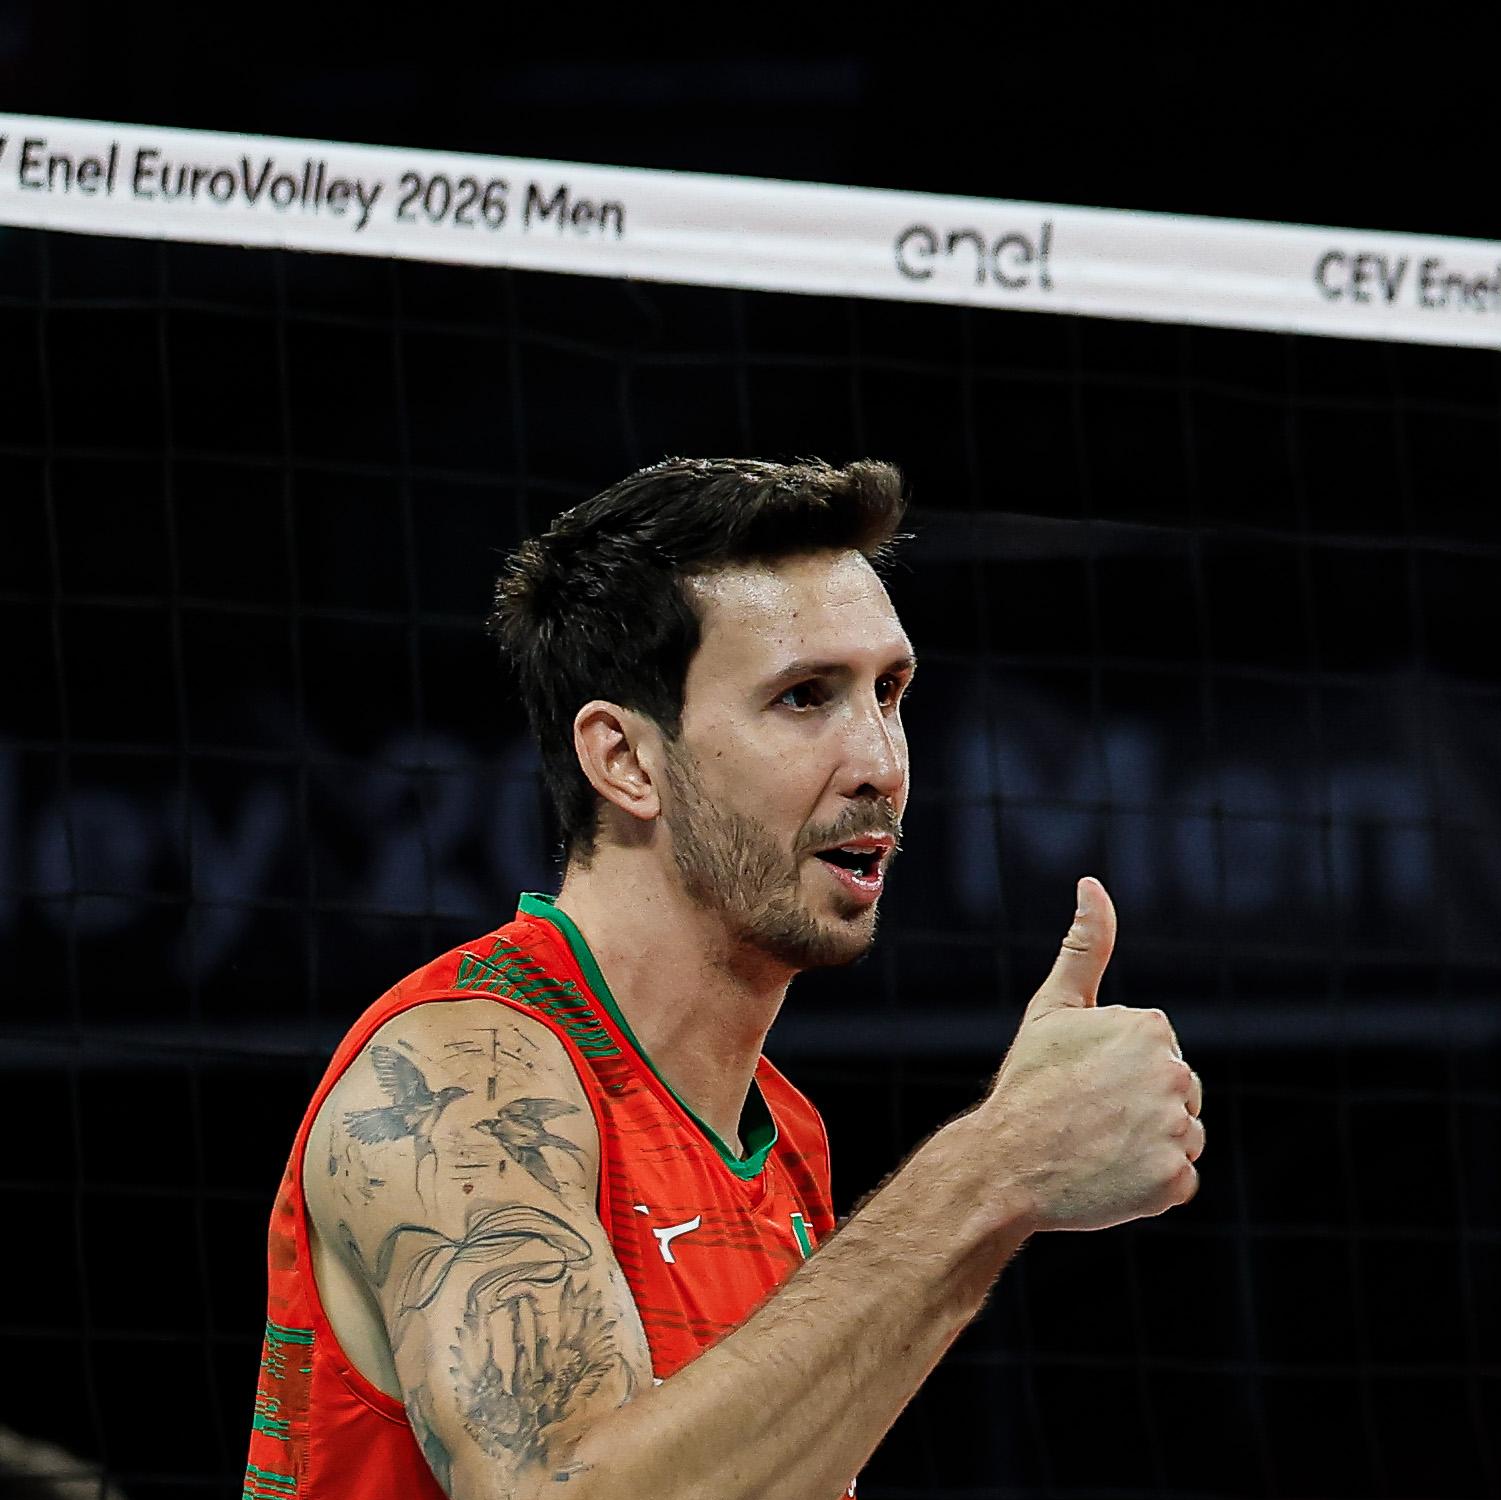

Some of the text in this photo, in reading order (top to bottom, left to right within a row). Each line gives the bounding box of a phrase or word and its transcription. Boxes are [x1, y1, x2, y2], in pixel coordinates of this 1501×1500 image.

[20, 136, 118, 198] Enel
[132, 149, 383, 232] EuroVolley
[396, 171, 510, 230] 2026
[522, 183, 627, 241] Men
[894, 221, 1053, 291] enel
[1314, 250, 1409, 304] CEV
